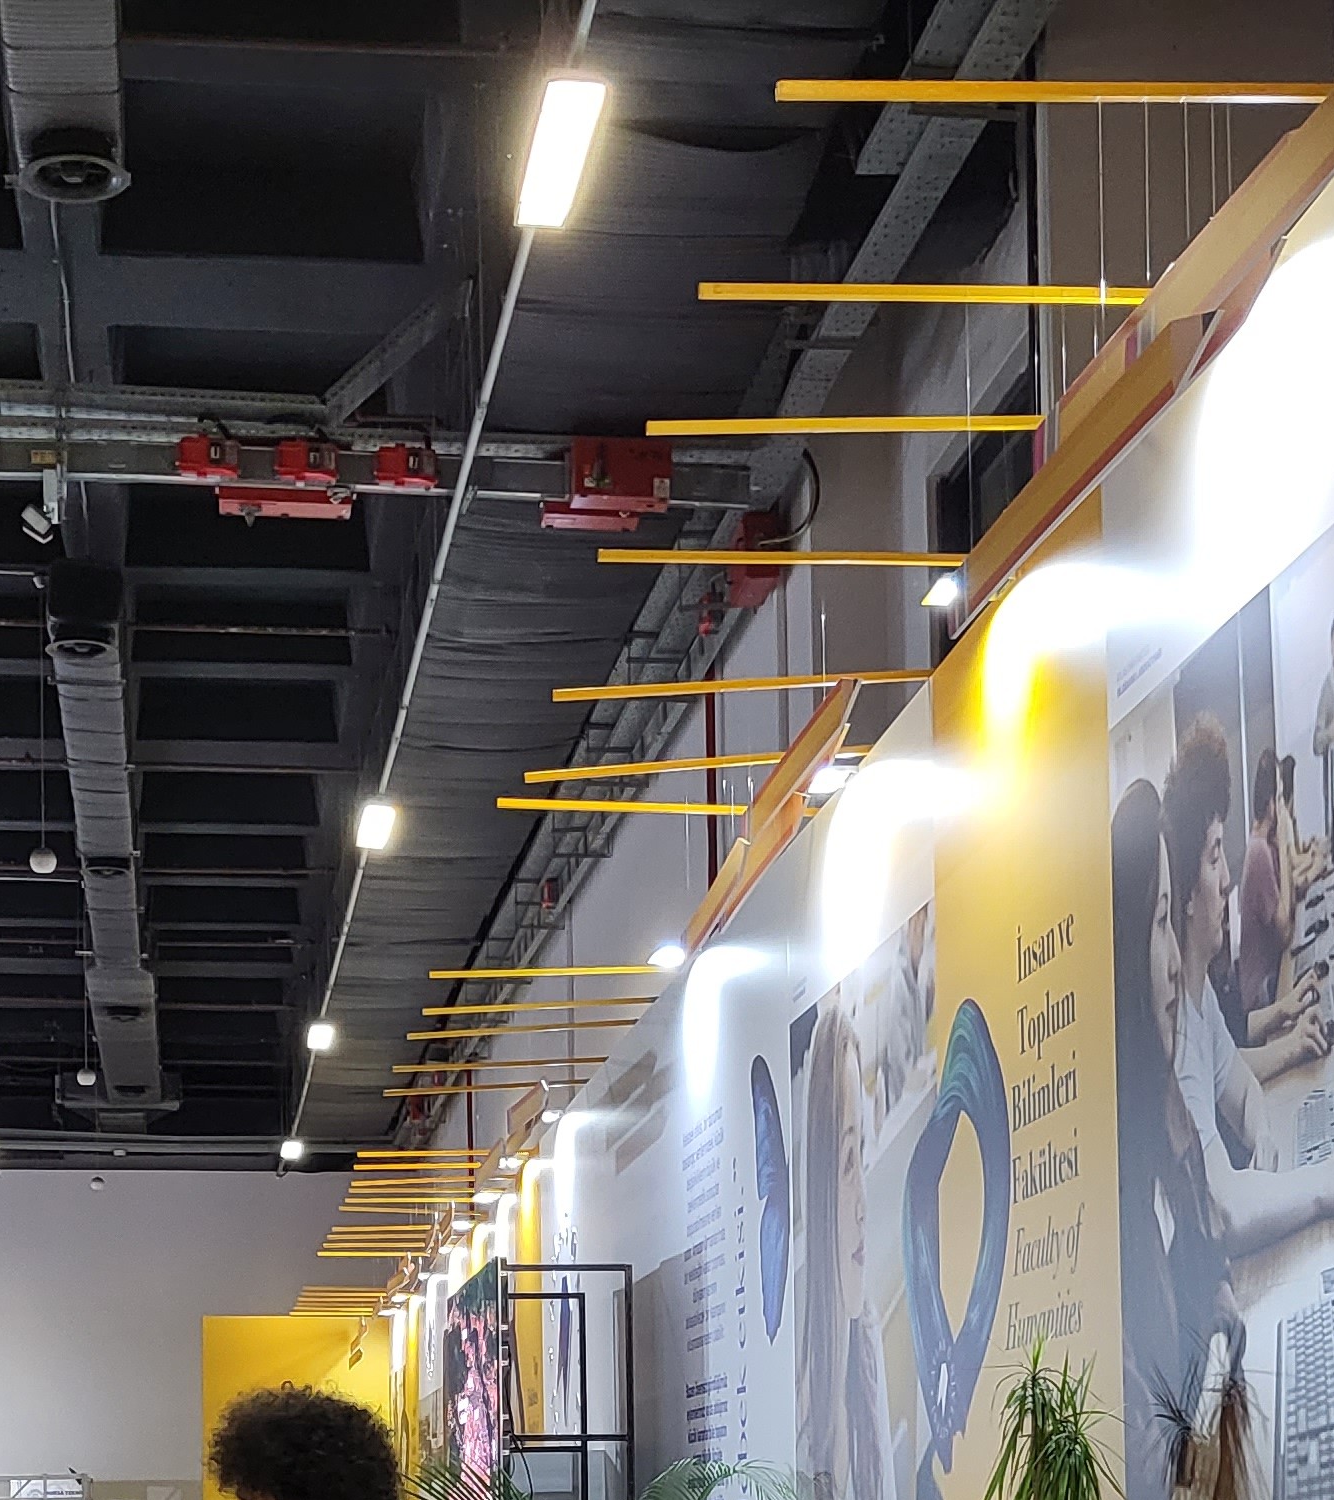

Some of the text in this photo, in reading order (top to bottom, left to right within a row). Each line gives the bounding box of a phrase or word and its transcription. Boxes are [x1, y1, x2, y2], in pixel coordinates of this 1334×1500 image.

[1016, 913, 1075, 984] İnsan ve
[1016, 989, 1076, 1061] Toplum
[1011, 1050, 1078, 1133] Bilimleri
[1011, 1127, 1080, 1204] Fakültesi
[1012, 1202, 1085, 1280] Faculty of
[1004, 1288, 1084, 1351] Humanities
